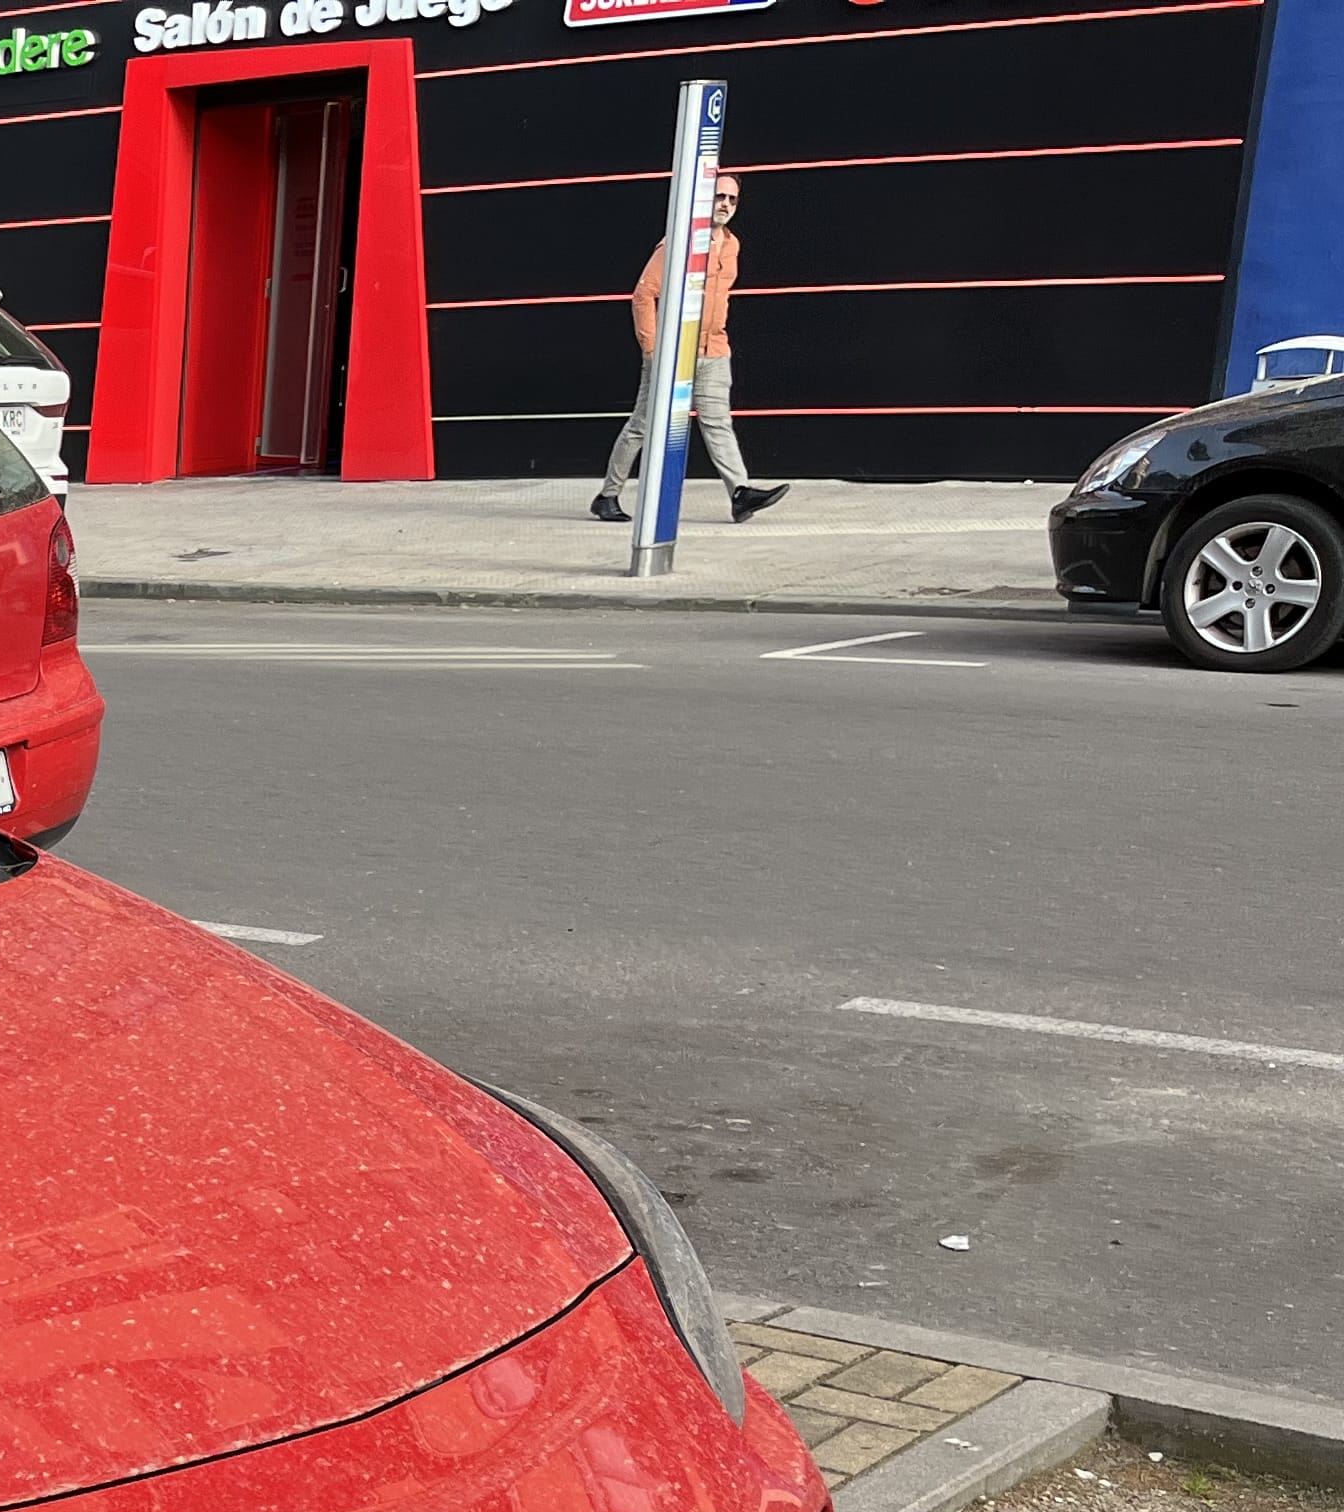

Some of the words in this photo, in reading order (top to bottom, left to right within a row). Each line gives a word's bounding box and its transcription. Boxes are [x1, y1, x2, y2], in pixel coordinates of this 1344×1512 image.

[133, 0, 268, 53] Salón
[279, 0, 344, 36] de
[2, 410, 23, 428] KRC
